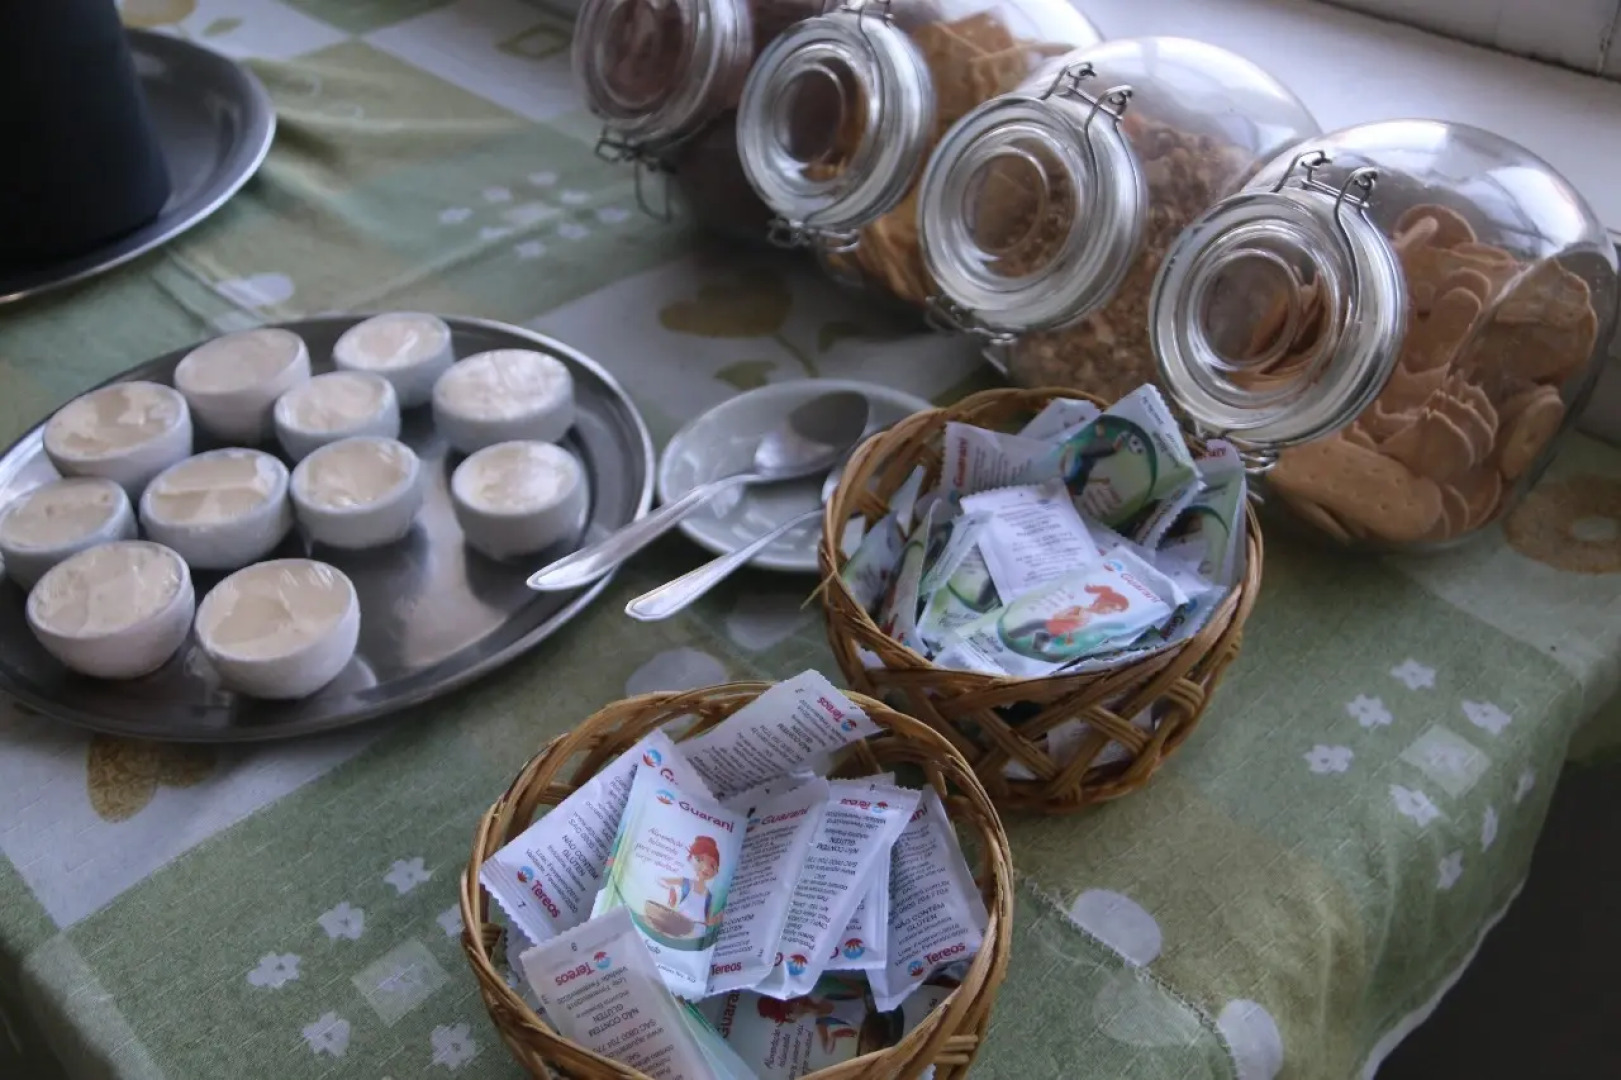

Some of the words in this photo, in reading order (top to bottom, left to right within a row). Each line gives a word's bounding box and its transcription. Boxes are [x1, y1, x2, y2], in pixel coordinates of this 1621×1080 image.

[817, 697, 845, 723] Tereos
[678, 801, 734, 833] Guarani
[761, 806, 810, 825] Guarani
[531, 880, 560, 918] Tereos
[923, 942, 966, 965] Tereos
[555, 962, 596, 987] Tereos
[710, 961, 742, 976] Tereos
[621, 1007, 640, 1021] NÃO
[717, 989, 741, 1039] Guara
